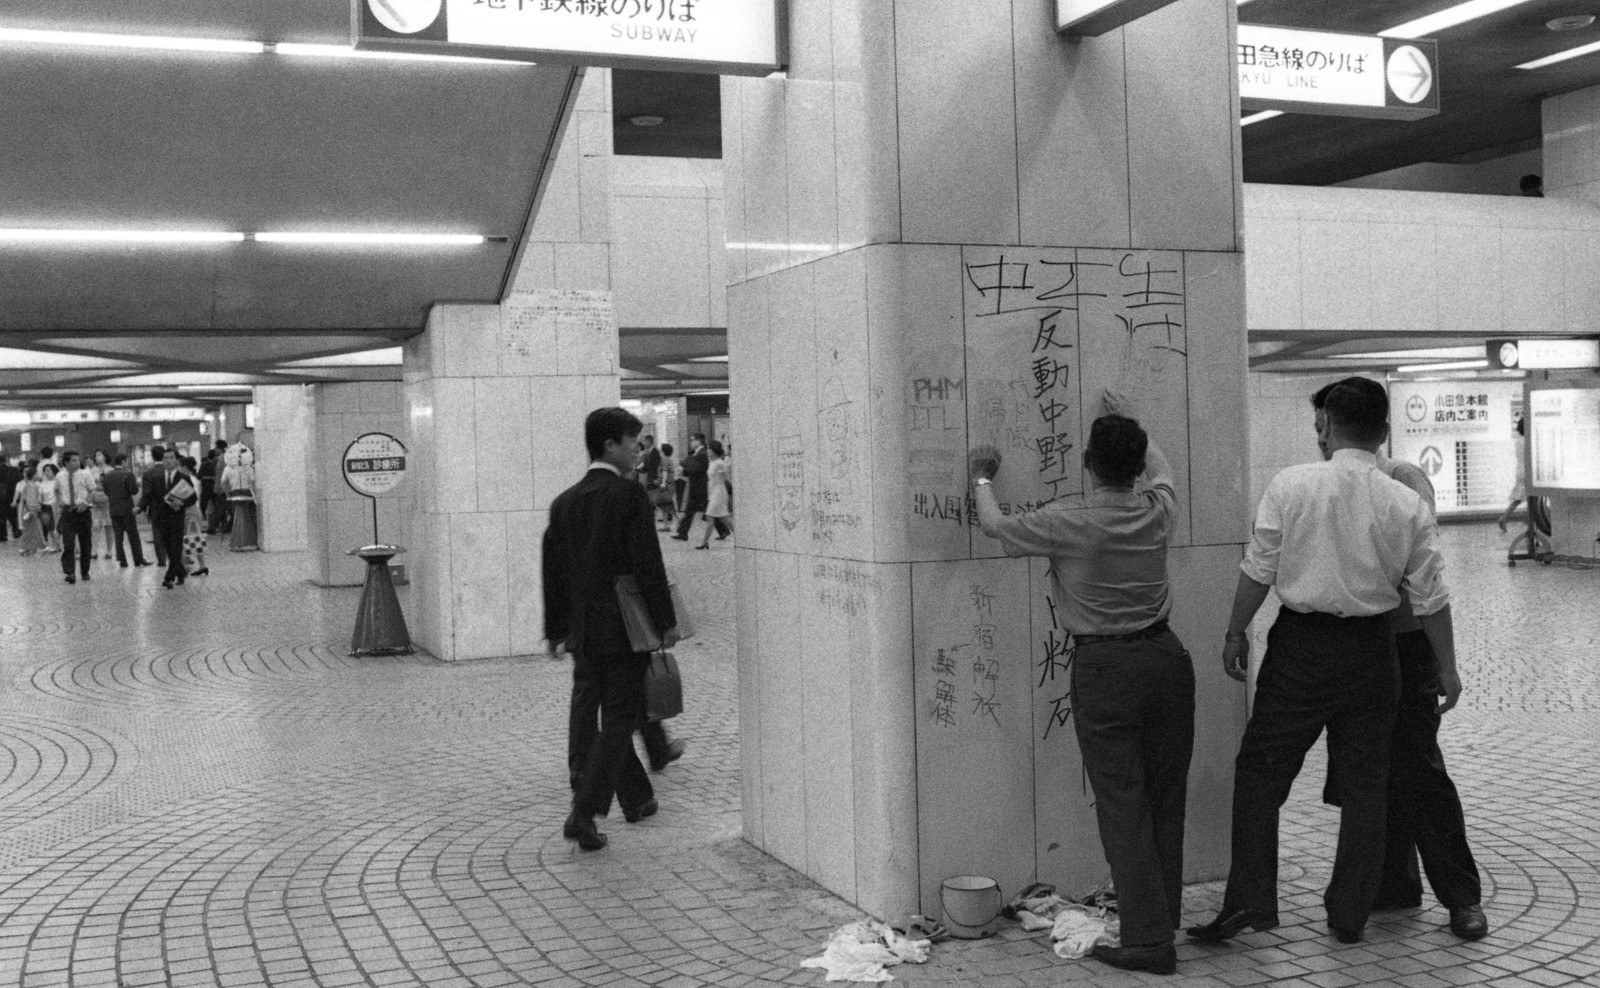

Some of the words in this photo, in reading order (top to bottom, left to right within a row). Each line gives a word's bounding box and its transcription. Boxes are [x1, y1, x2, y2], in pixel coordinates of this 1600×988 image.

[611, 23, 698, 44] SUBWAY
[1287, 73, 1318, 89] LINE
[1435, 409, 1488, 422] 店内ご案内
